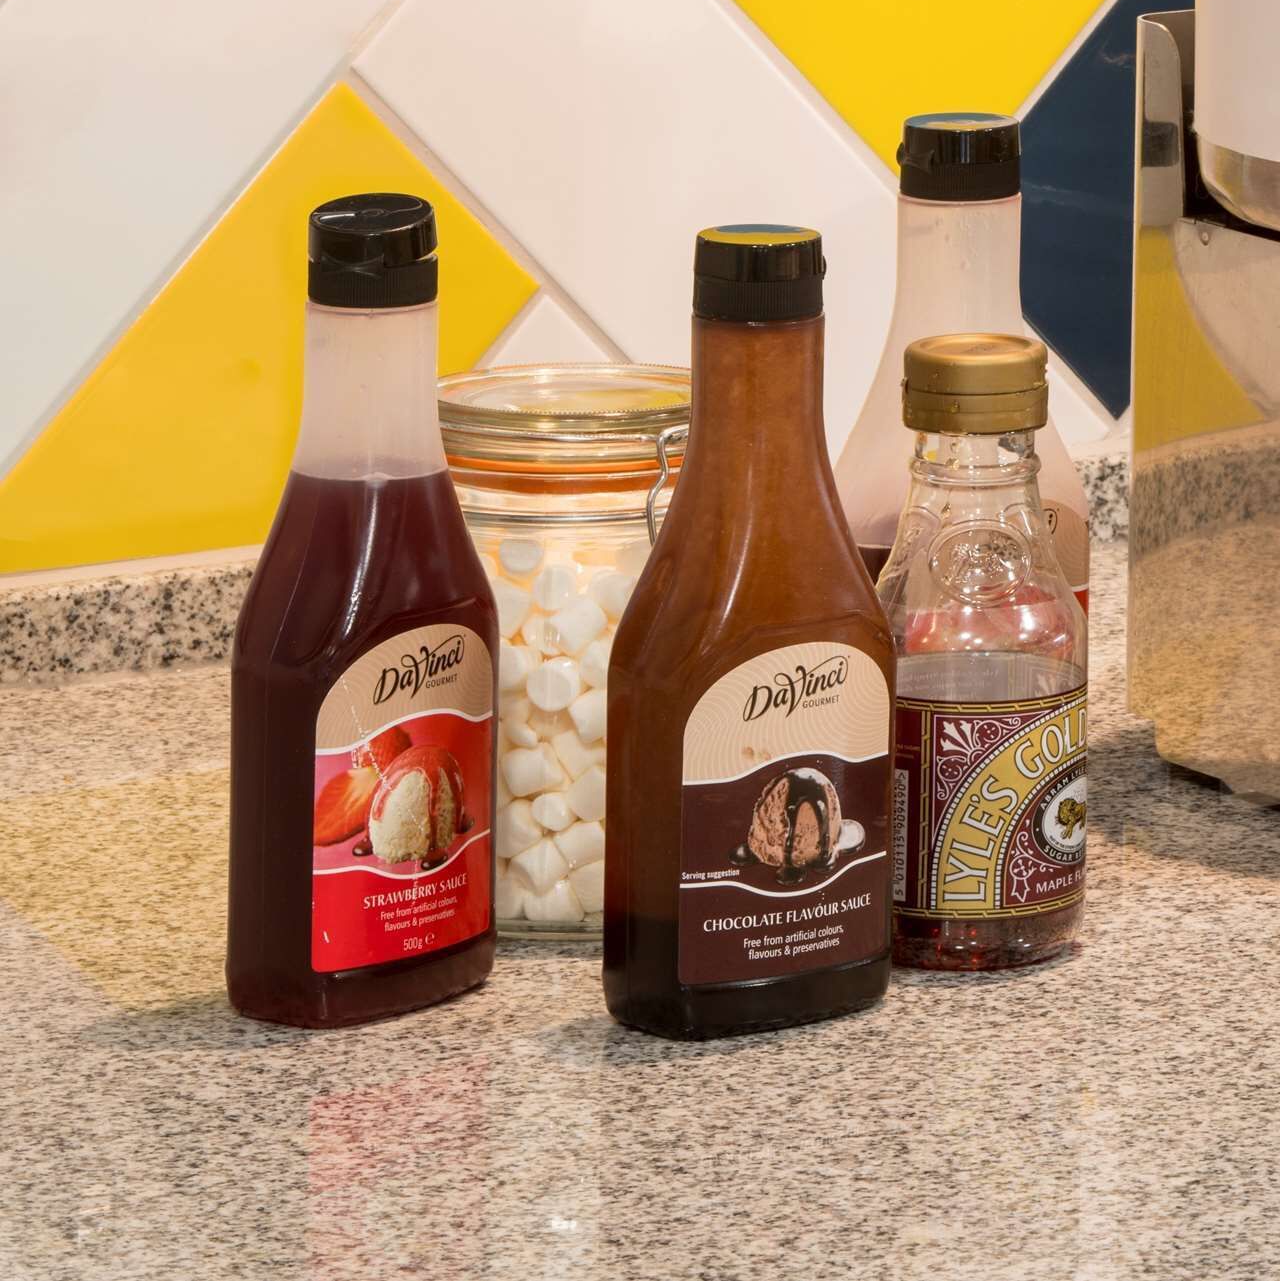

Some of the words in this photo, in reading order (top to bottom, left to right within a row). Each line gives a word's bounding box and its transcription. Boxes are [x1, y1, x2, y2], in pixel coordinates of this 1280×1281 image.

[373, 634, 465, 705] DaVinci
[425, 673, 458, 689] GOURMET
[743, 656, 848, 722] DaVinci
[802, 694, 840, 709] GOURMET
[943, 774, 1019, 903] LYLE'S
[1043, 845, 1073, 862] SUGAR
[681, 872, 705, 880] Serving
[707, 867, 740, 879] suggestion
[363, 882, 438, 909] STRAWBERRY
[440, 873, 468, 893] SAUCE
[1036, 878, 1073, 894] MAPLE
[380, 910, 395, 920] Free
[396, 907, 411, 918] from
[412, 899, 437, 913] artificial
[384, 919, 411, 932] flavours
[412, 917, 418, 926] &
[418, 908, 456, 927] preservatives
[703, 912, 783, 933] CHOCOLATE
[786, 901, 839, 923] FLAVOUR
[840, 892, 872, 913] SAUCE
[403, 935, 423, 951] 500g
[743, 937, 761, 949] Free
[763, 935, 783, 947] from
[785, 927, 817, 944] artificial
[818, 923, 844, 938] colours,
[748, 946, 782, 960] flavours
[784, 945, 791, 956] &
[792, 937, 840, 956] preservatives
